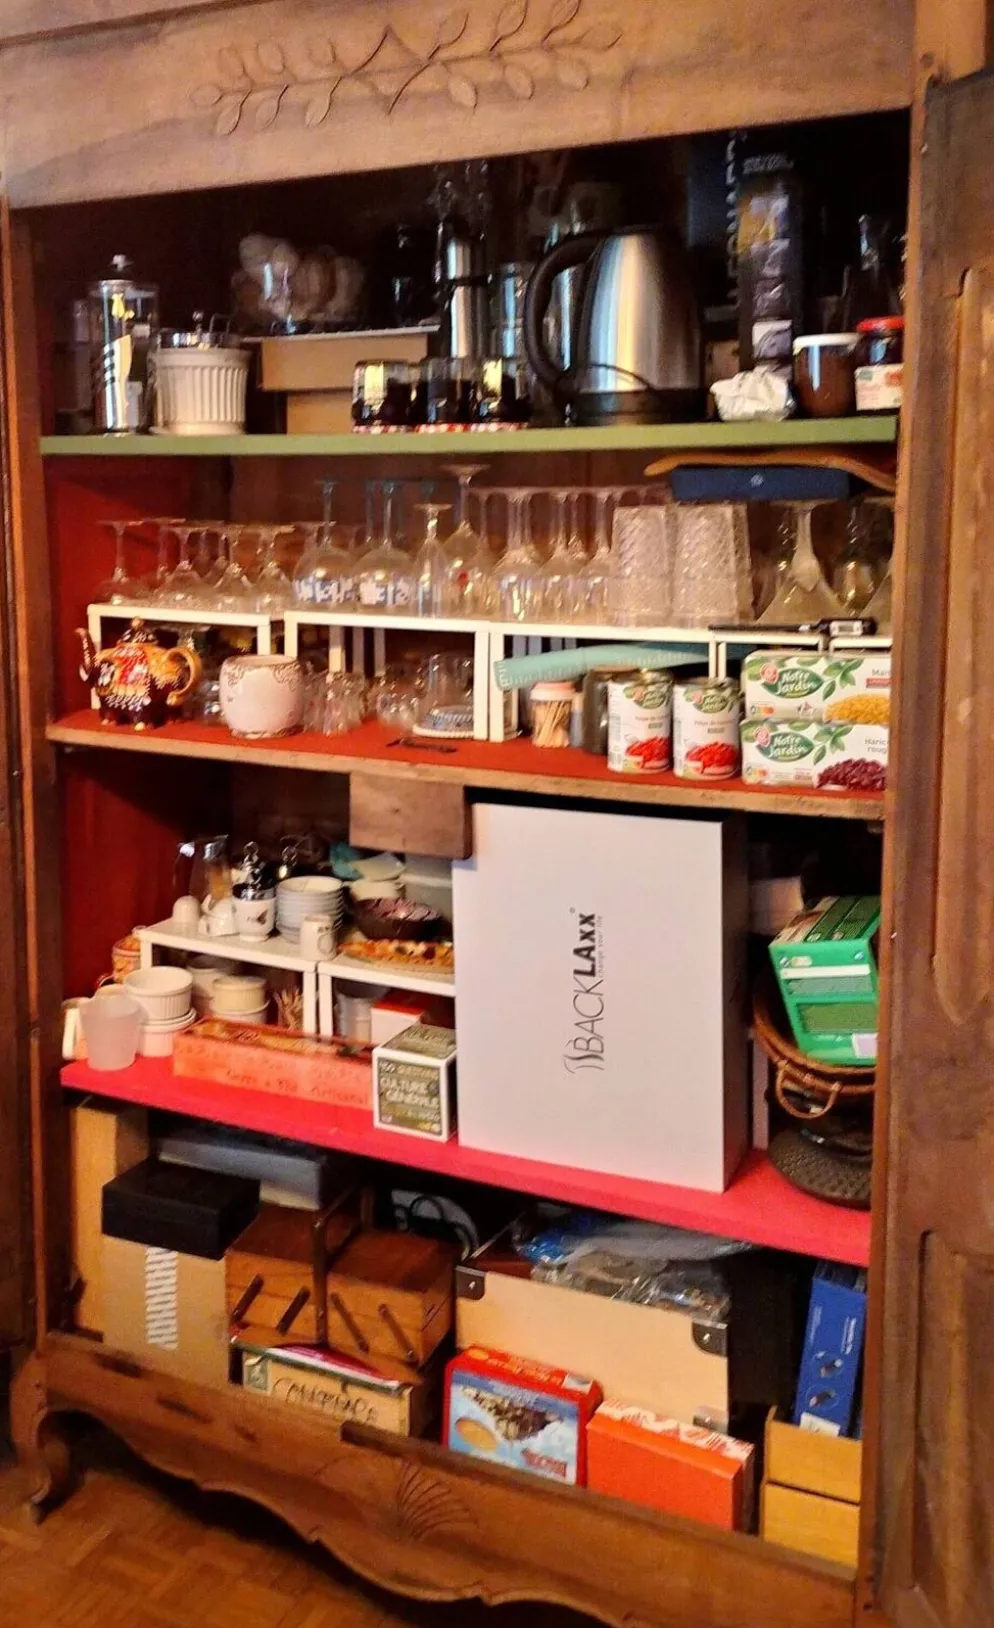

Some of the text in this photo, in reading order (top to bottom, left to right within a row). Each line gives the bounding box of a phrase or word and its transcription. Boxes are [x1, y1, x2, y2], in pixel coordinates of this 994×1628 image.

[782, 671, 810, 681] Notre
[776, 681, 818, 695] Jardin
[774, 735, 801, 745] Notre
[769, 744, 806, 758] Jardin
